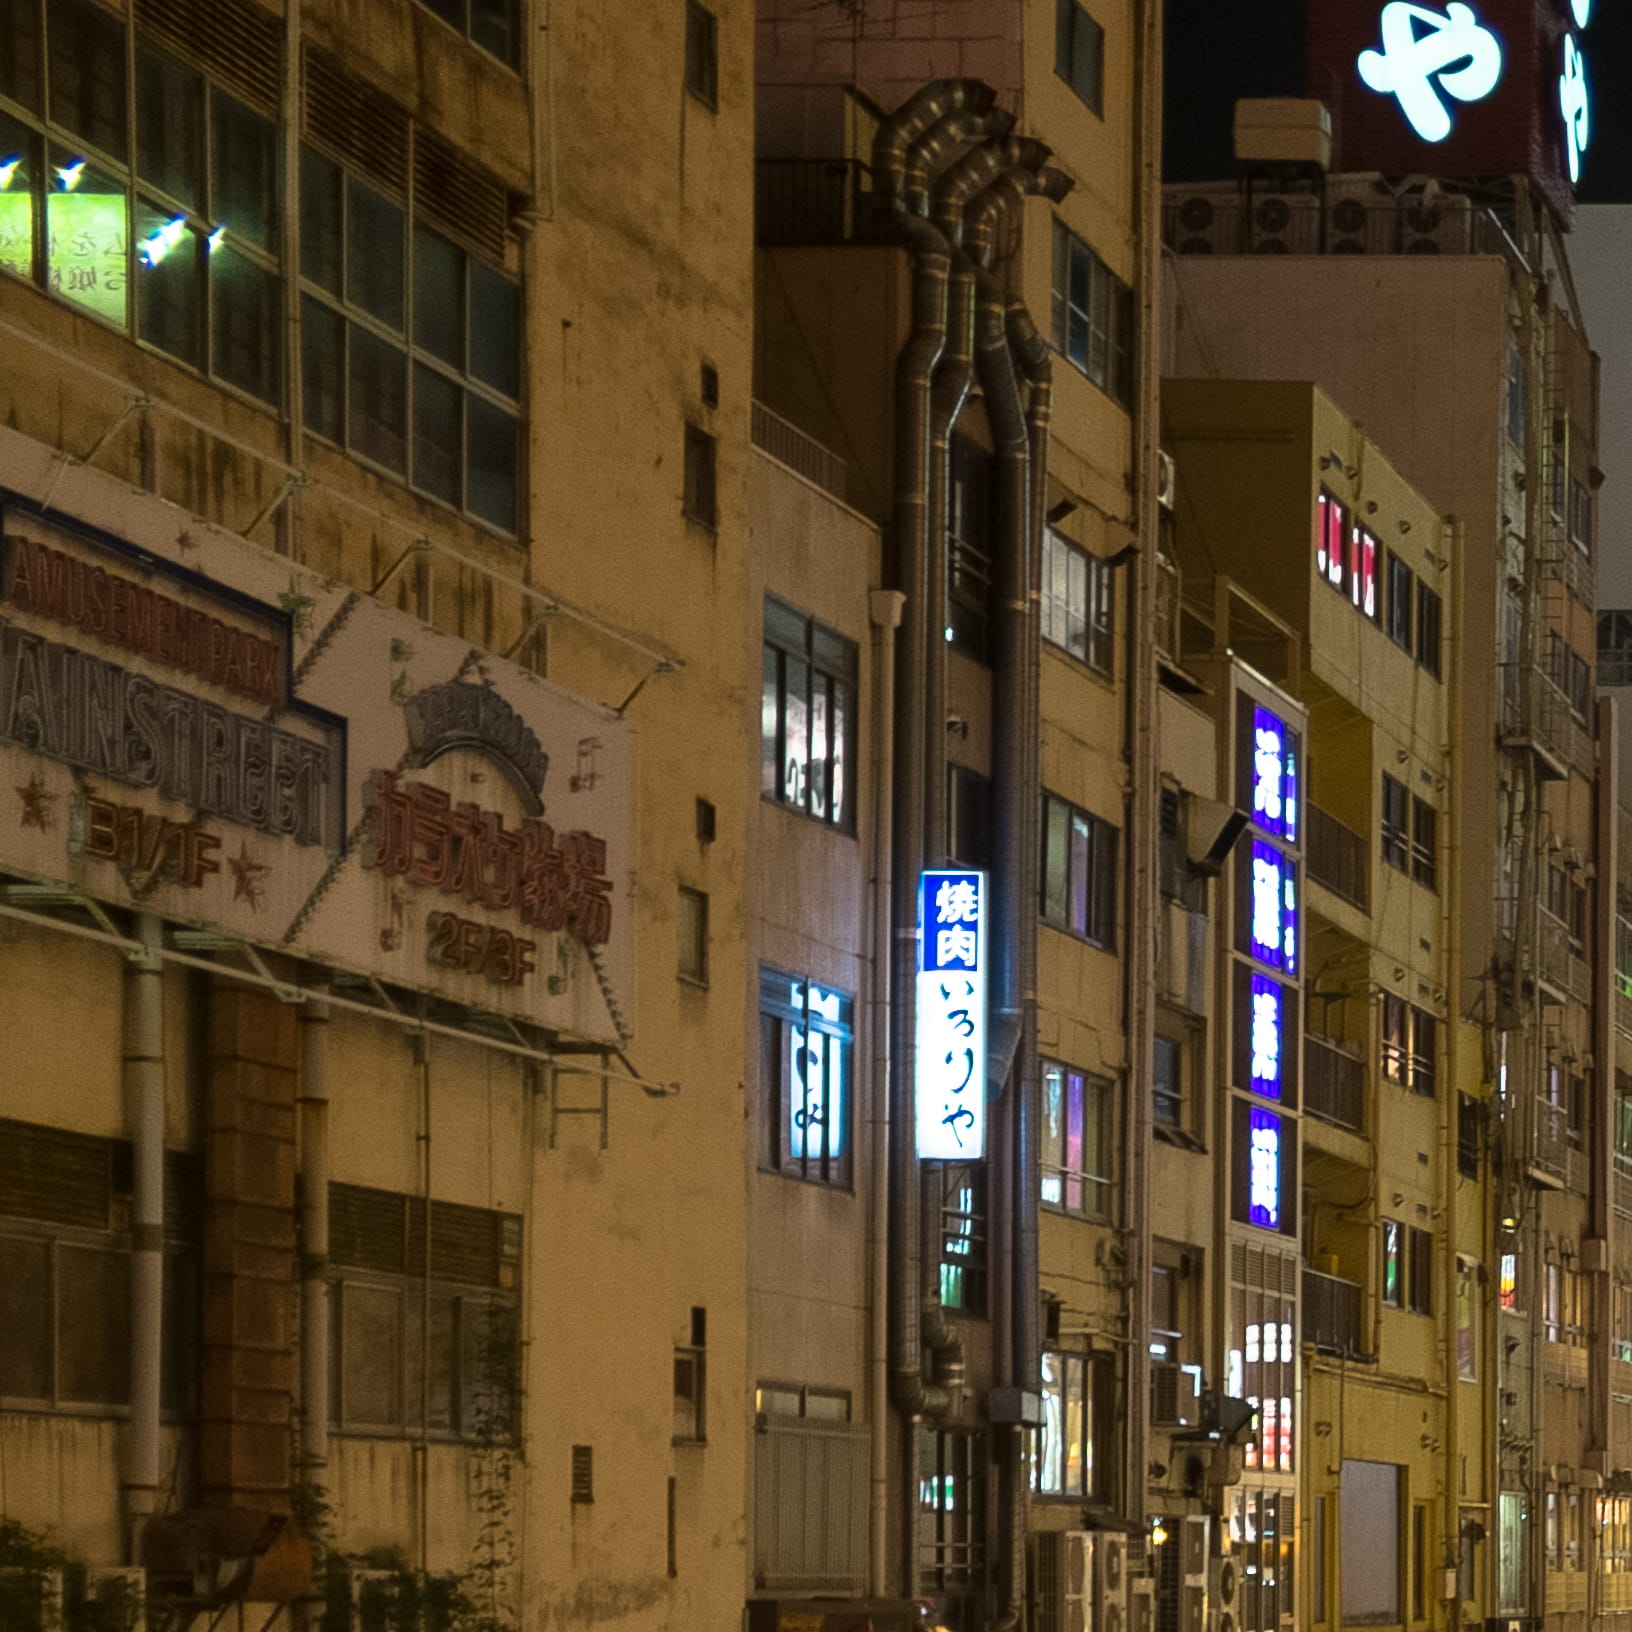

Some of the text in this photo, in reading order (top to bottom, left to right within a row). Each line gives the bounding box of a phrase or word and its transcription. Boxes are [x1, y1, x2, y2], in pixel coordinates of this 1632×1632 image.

[1357, 1, 1502, 142] や
[1560, 0, 1590, 183] や
[11, 535, 282, 704] AMUSEMENT PARK
[936, 880, 979, 1148] 焼肉 いろりや
